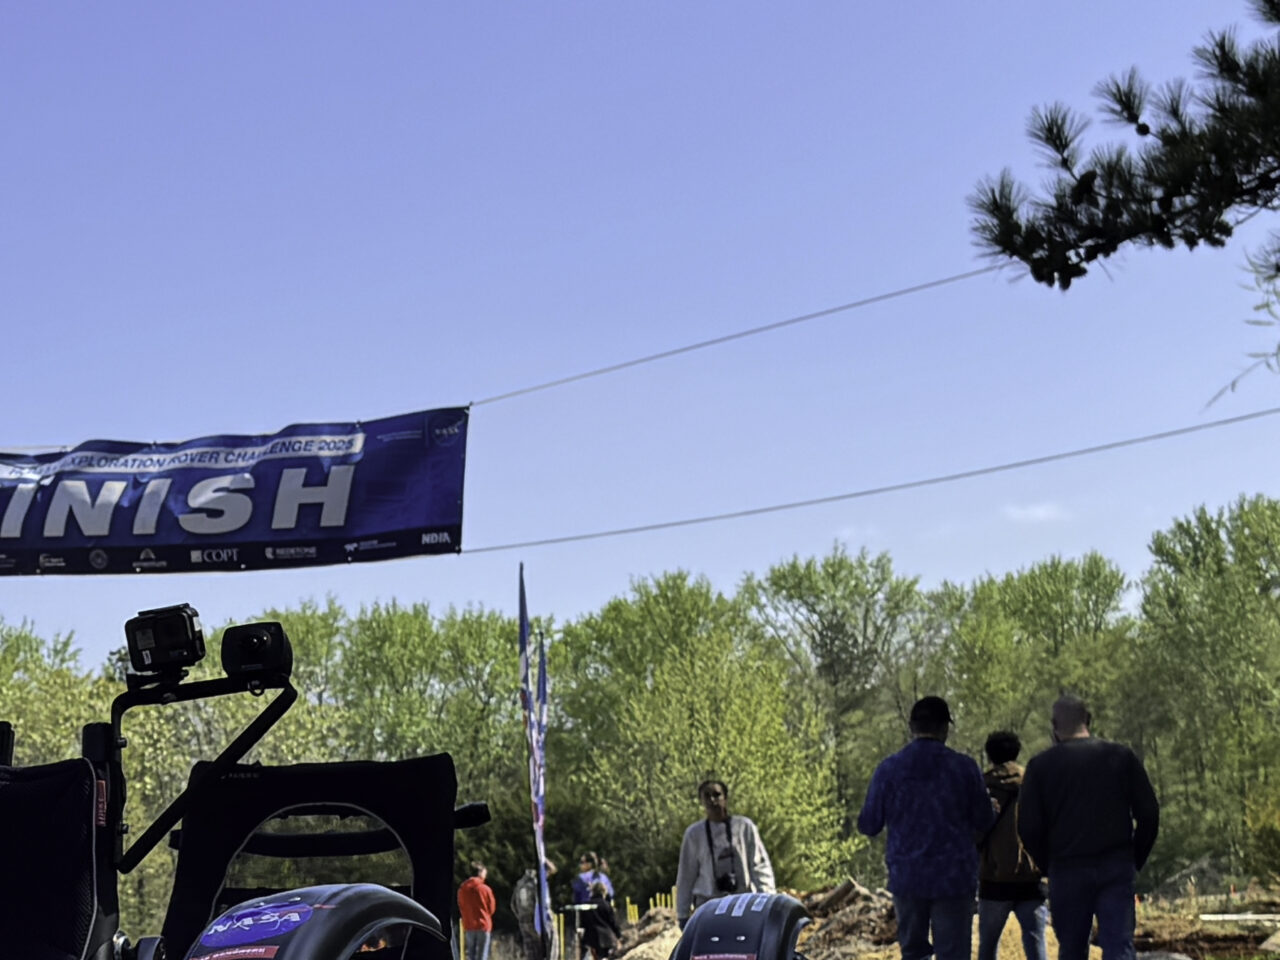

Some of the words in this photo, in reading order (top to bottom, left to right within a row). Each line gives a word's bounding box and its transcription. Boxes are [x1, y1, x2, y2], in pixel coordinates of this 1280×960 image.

[170, 451, 220, 465] ROVER
[318, 438, 355, 451] 2025
[204, 549, 238, 562] COPT
